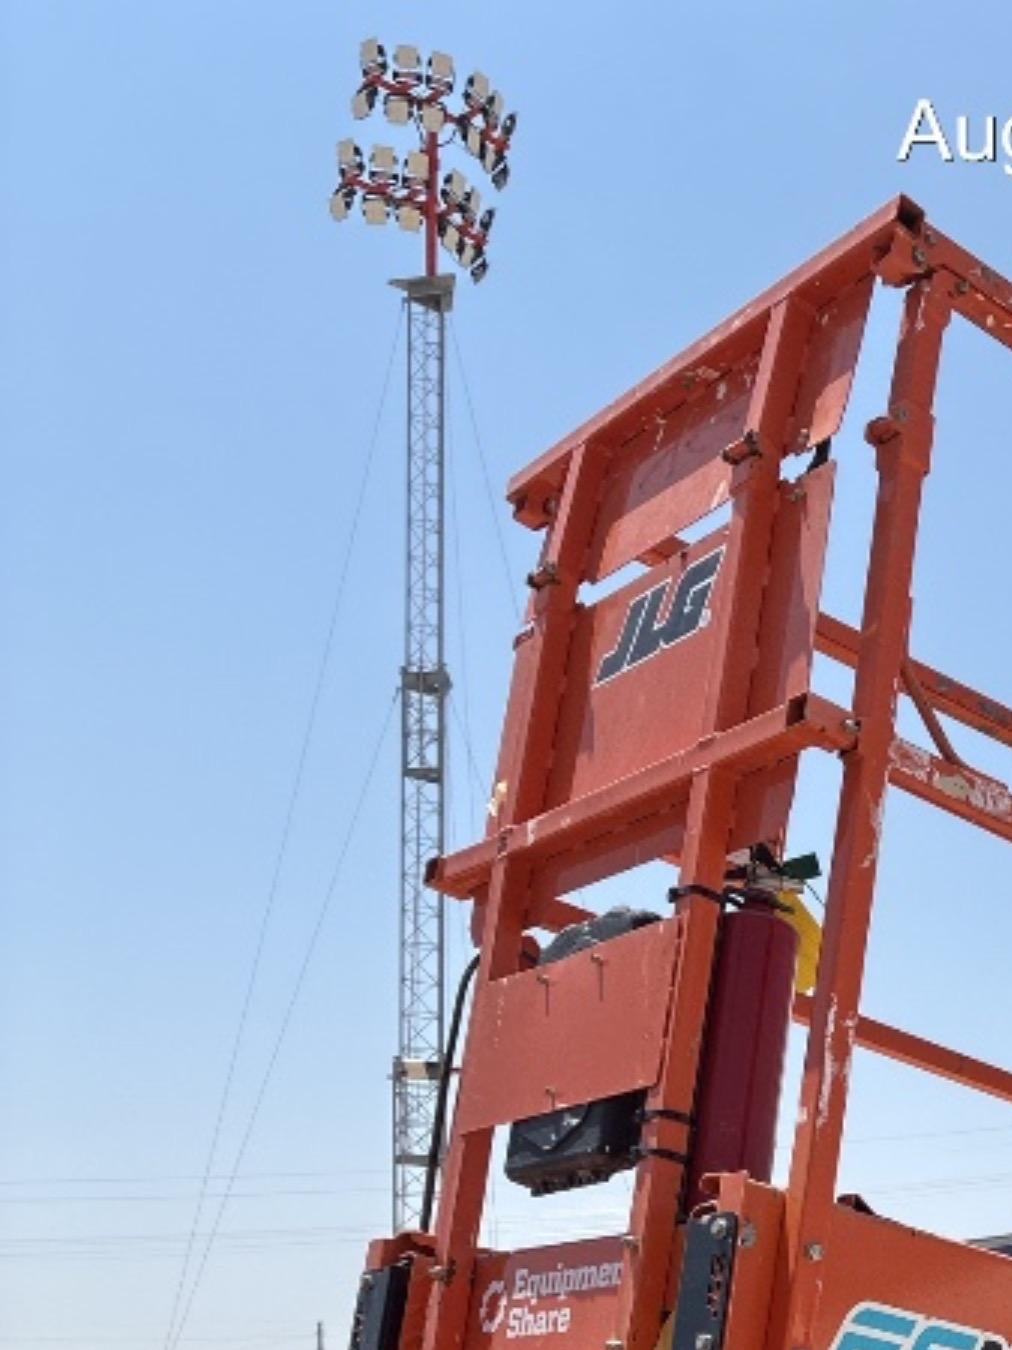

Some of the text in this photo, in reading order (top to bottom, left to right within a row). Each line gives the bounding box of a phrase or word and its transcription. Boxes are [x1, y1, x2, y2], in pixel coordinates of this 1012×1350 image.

[591, 544, 727, 691] JLG
[511, 1261, 625, 1306] Equipmen
[506, 1306, 571, 1339] Share
